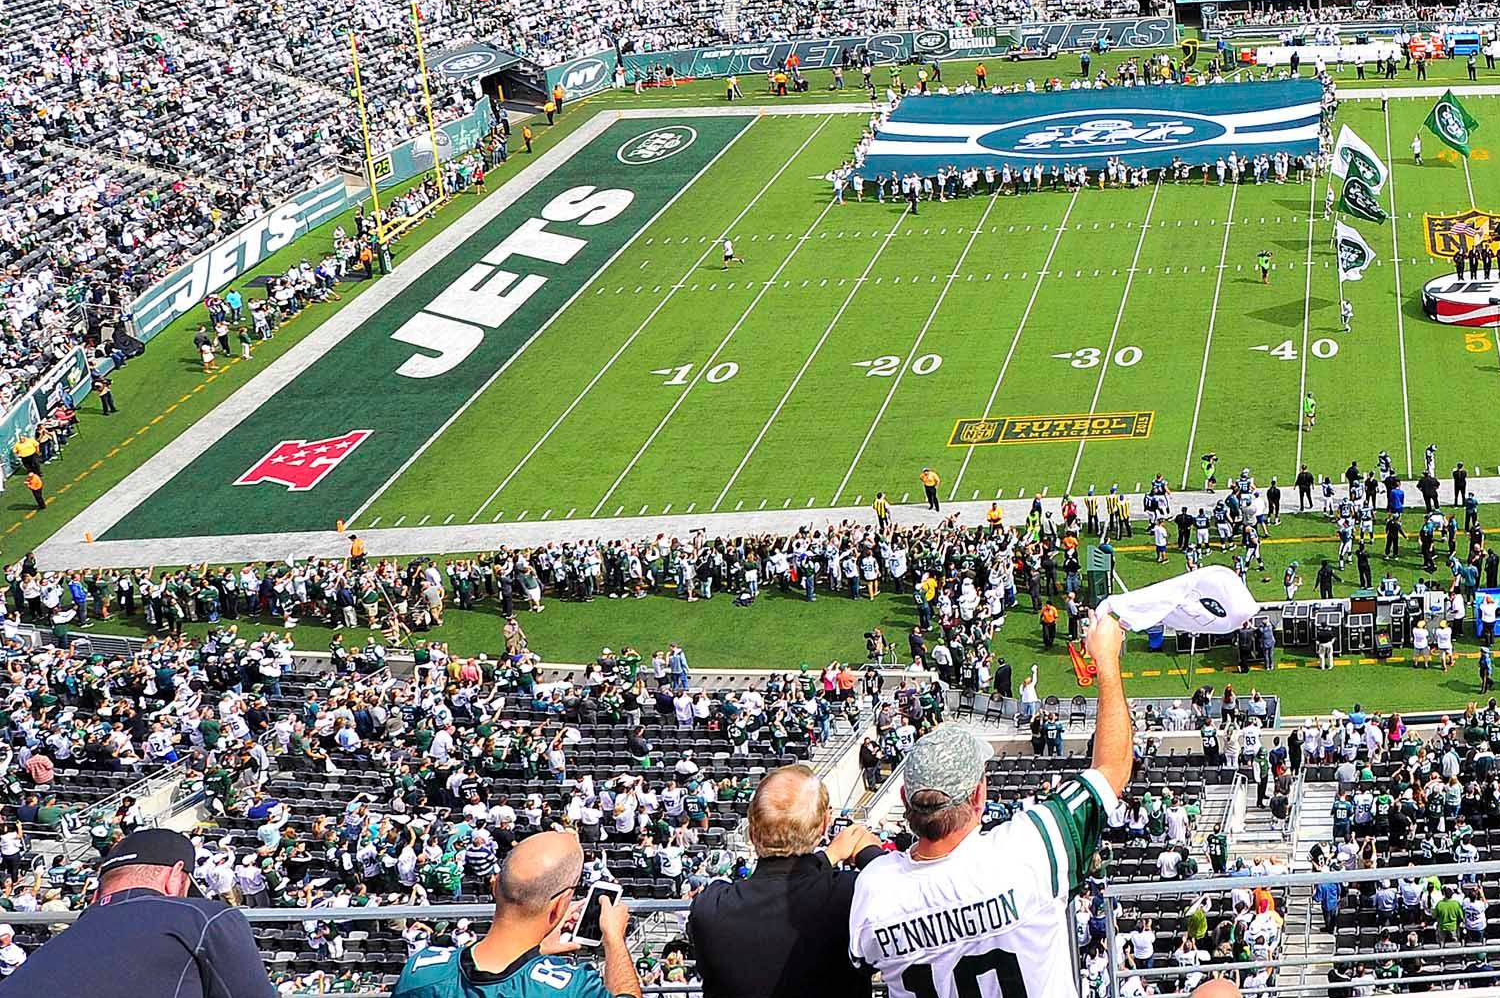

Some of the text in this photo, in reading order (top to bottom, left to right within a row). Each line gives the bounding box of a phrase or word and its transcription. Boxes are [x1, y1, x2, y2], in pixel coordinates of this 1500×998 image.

[948, 27, 975, 39] FEEL
[949, 37, 997, 50] ORGULLO
[1023, 19, 1171, 51] JETS
[702, 47, 769, 60] NEW YORK
[748, 34, 906, 74] JETS
[566, 62, 604, 88] NY
[375, 158, 392, 177] 25
[175, 203, 300, 313] JETS
[390, 186, 635, 379] JETS
[1071, 346, 1144, 369] 30
[1268, 338, 1340, 361] 40
[661, 360, 740, 386] 10
[865, 353, 944, 378] 20
[1012, 417, 1127, 433] FUTBOL
[1018, 429, 1112, 438] AMERICANO
[875, 888, 1020, 958] PENNINGTON
